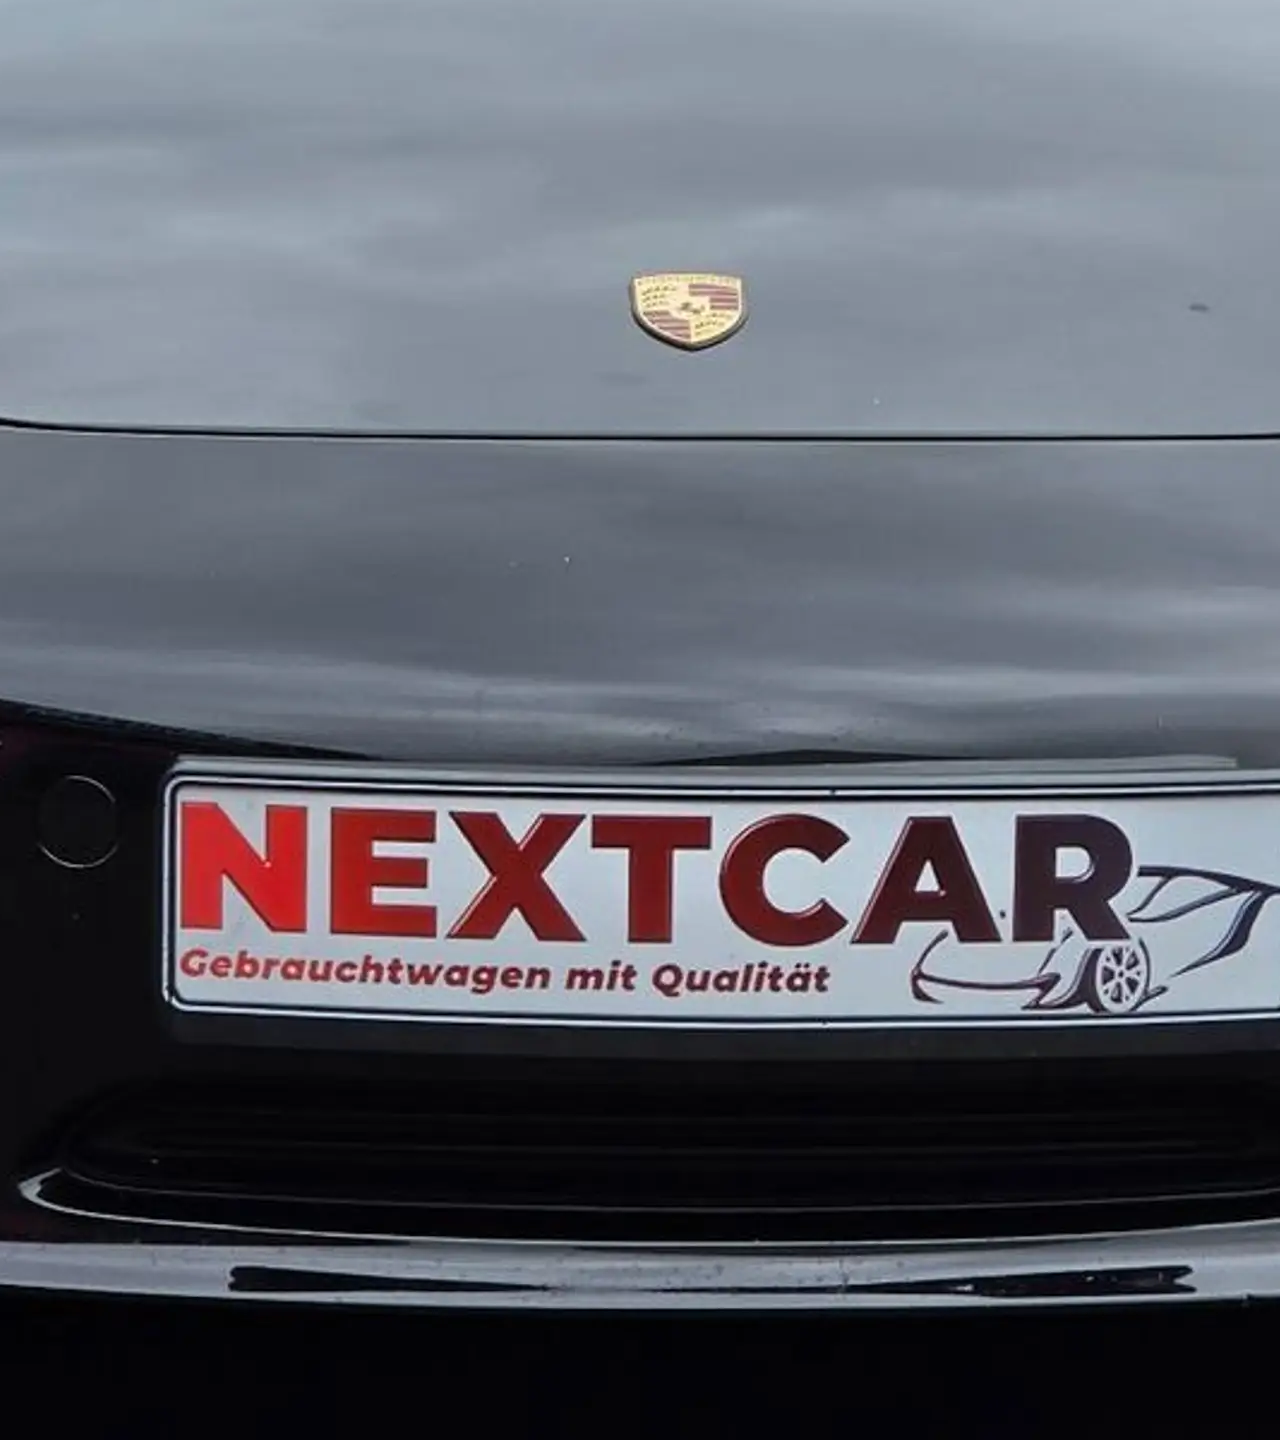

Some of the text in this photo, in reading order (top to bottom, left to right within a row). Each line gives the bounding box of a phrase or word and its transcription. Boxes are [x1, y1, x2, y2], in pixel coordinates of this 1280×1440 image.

[180, 801, 1133, 947] NEXTCAR
[179, 947, 831, 999] Gebrauchtwagen mit Qualität
